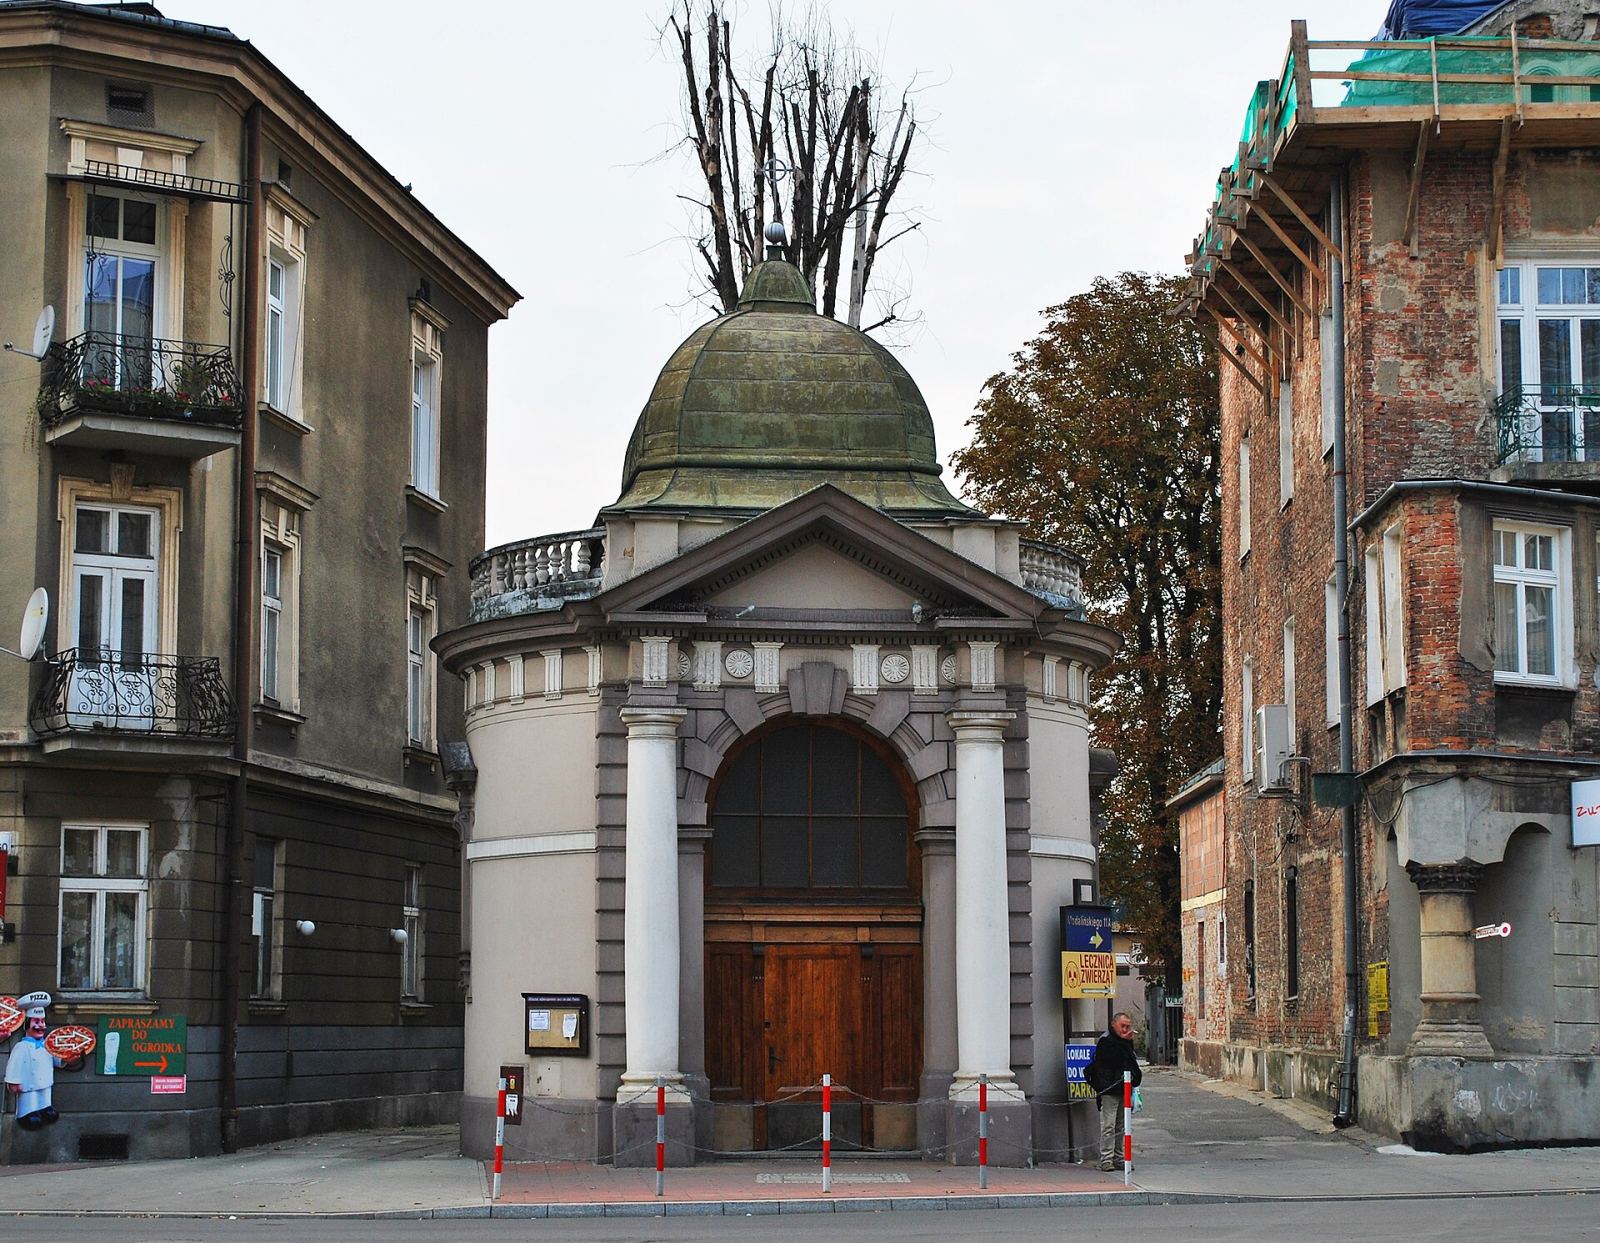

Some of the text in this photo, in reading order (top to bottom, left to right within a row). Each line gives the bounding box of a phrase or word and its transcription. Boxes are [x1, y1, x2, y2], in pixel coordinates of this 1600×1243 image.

[1080, 954, 1114, 969] LECZNICA
[108, 1018, 175, 1029] ZAPRASZAMY
[132, 1030, 148, 1041] DO
[1067, 1049, 1091, 1060] LOKALE
[1067, 1067, 1078, 1078] DO
